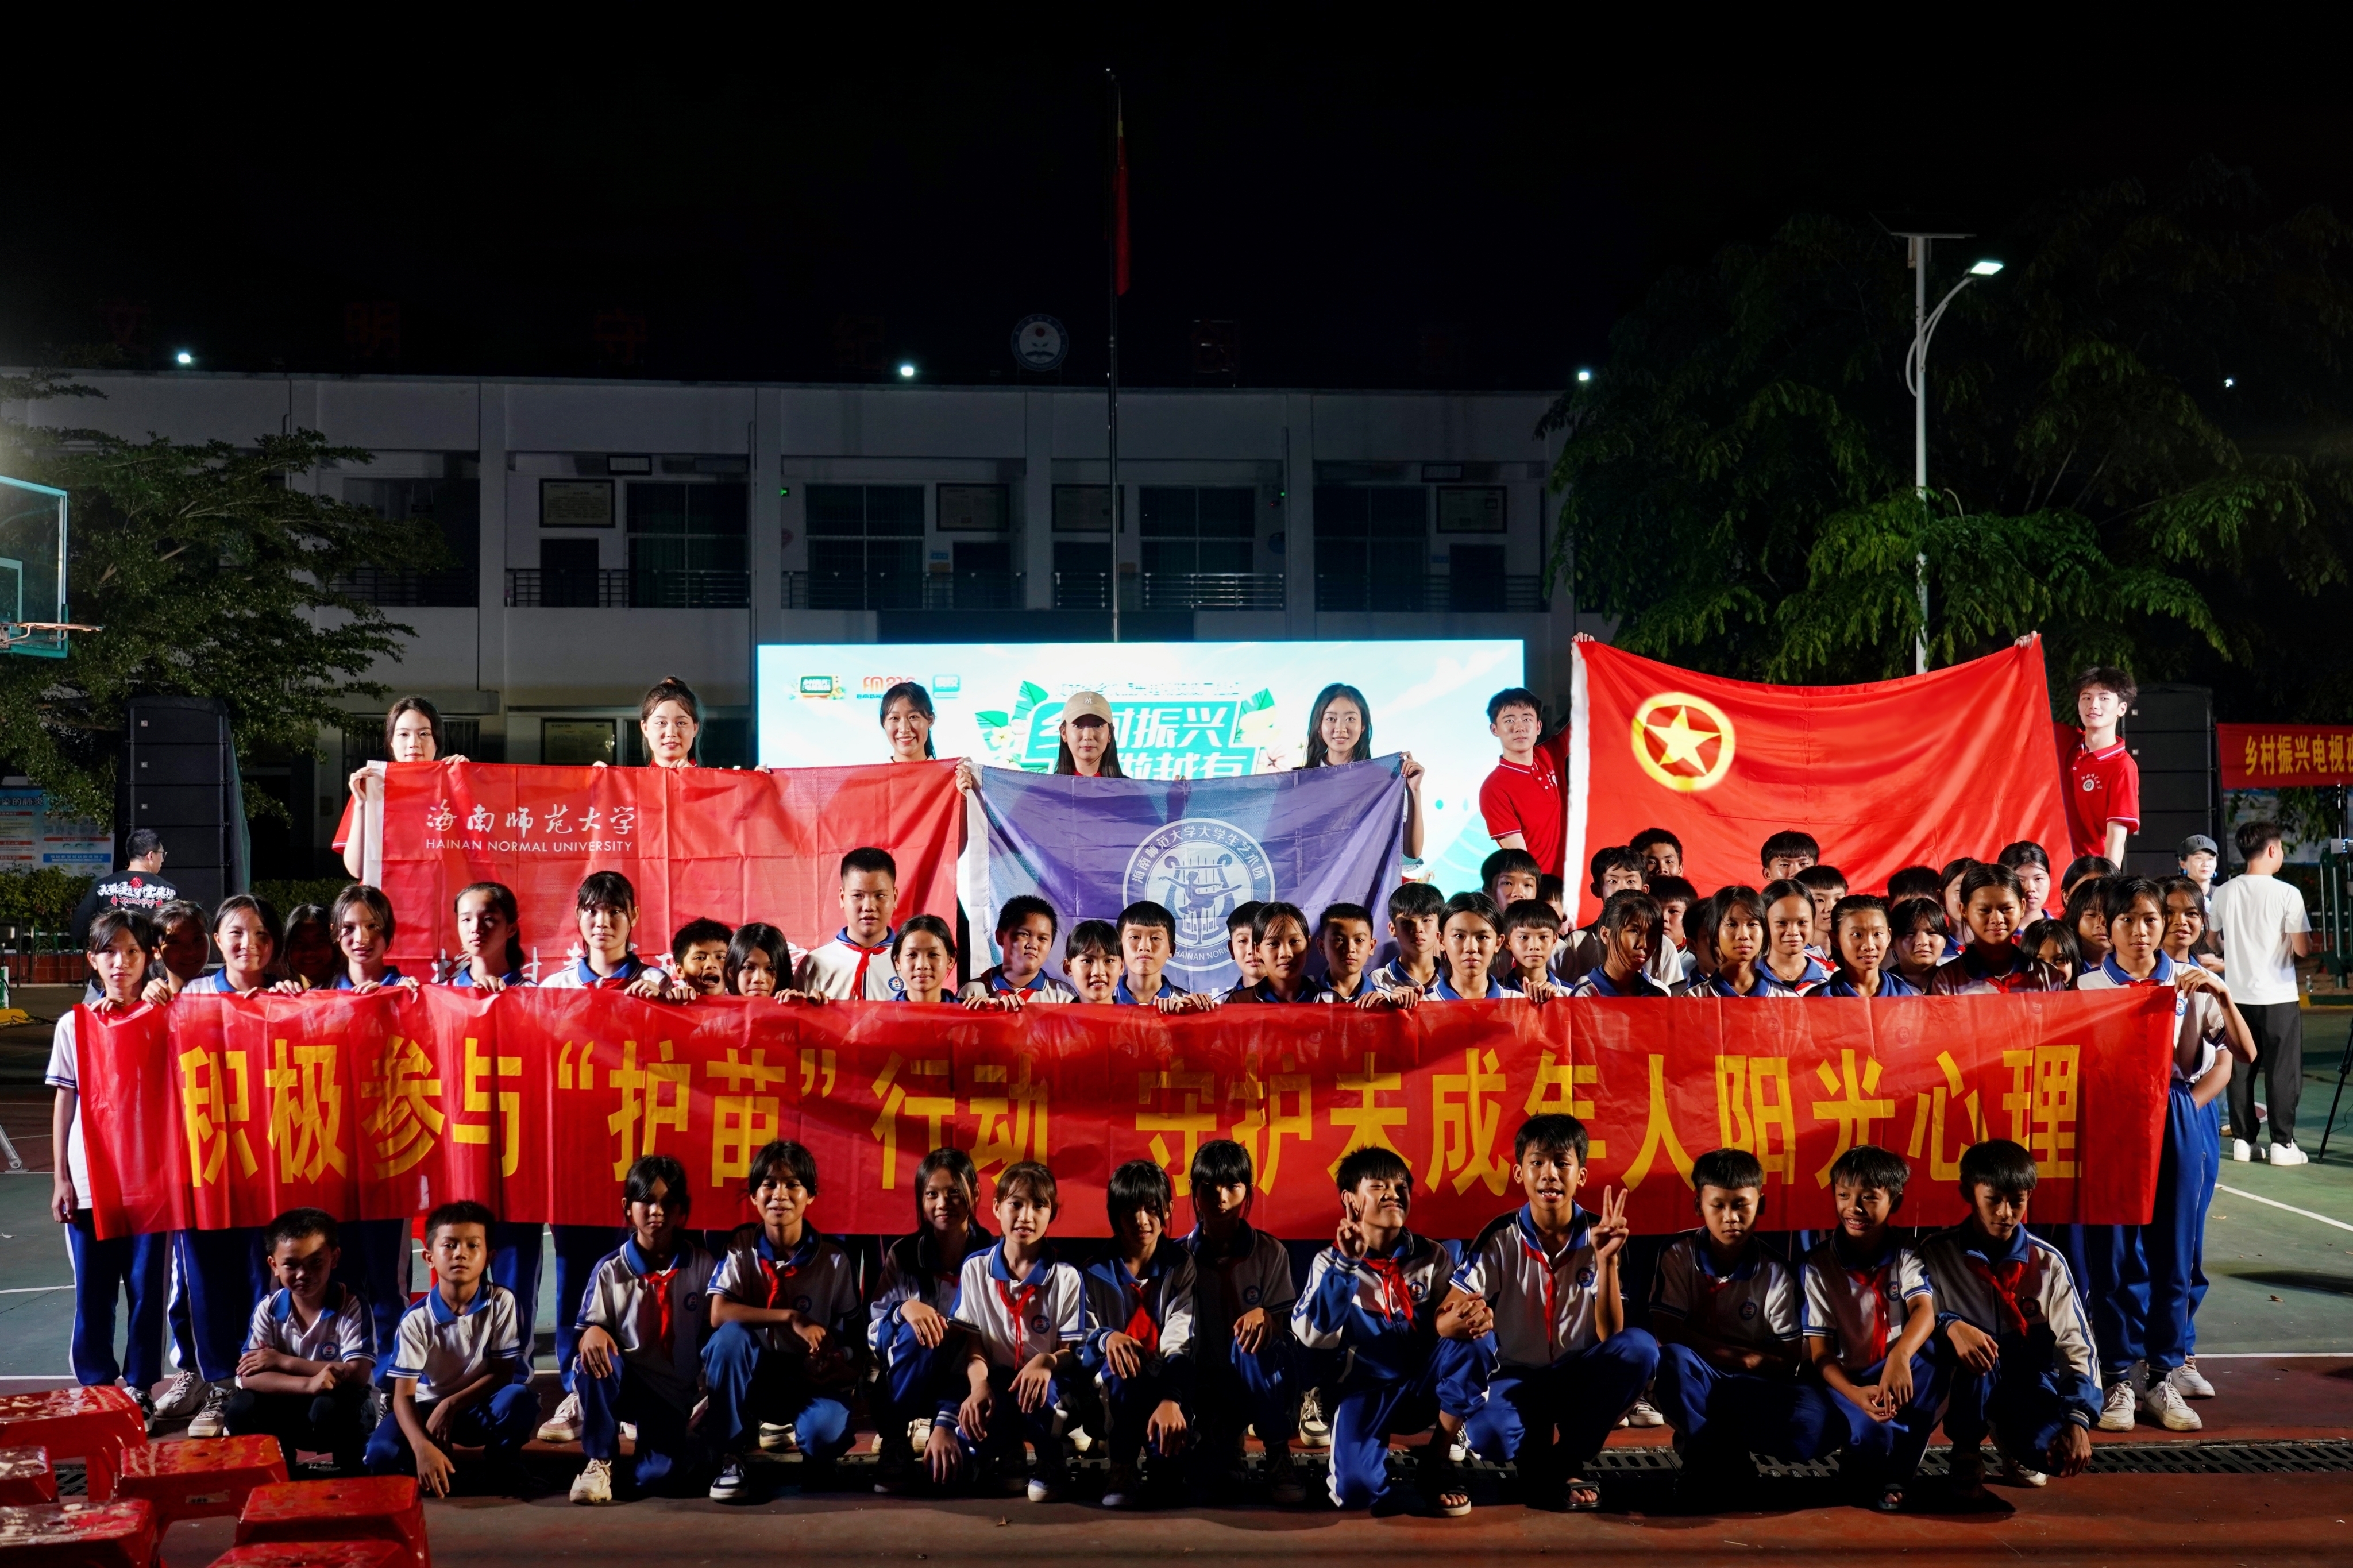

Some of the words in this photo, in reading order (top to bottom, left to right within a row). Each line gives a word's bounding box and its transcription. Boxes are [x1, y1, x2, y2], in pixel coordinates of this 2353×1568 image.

[1036, 707, 1228, 748] 乡振兴
[426, 799, 635, 838] 海南师范大学
[426, 839, 481, 851] HAINAN
[488, 841, 548, 852] NORMAL
[553, 840, 632, 852] UNIVERSITY
[1131, 825, 1266, 884] 海南师范大学大学生艺术团
[1175, 949, 1205, 960] HAINAN
[179, 1035, 1048, 1190] 积极参与“护苗”行动
[1135, 1044, 2082, 1196] 守护未成年人阳光心理
